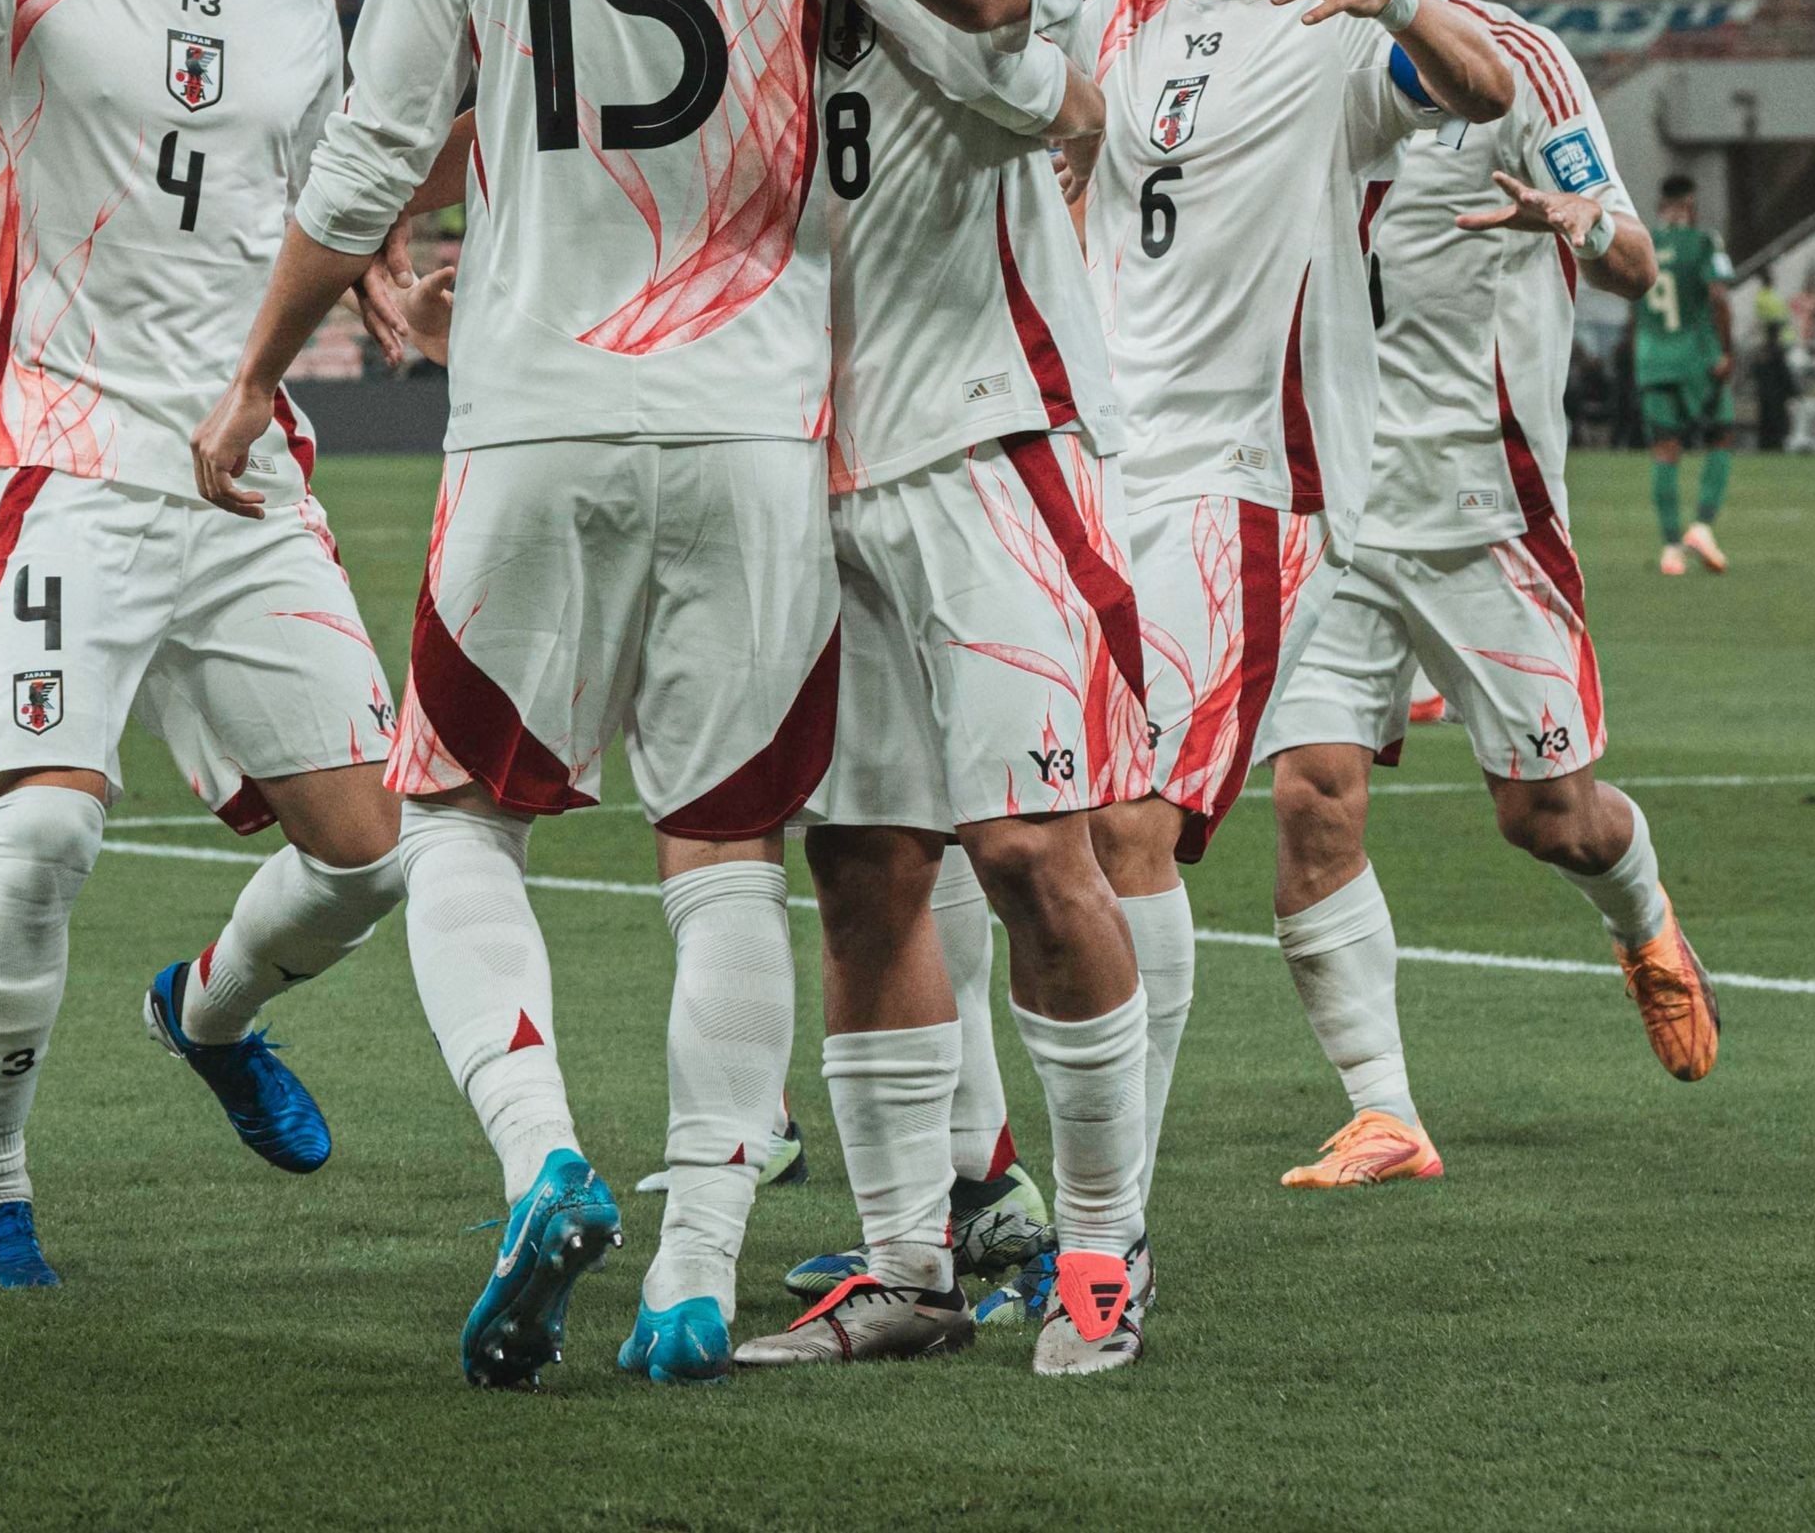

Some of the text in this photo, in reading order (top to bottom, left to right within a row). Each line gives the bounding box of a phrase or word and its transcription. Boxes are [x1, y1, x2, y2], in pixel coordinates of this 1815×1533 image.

[180, 33, 212, 46] JAPAN
[1184, 31, 1223, 60] Y-3
[825, 90, 871, 201] 8
[156, 129, 206, 233] 4
[1139, 165, 1184, 259] 6
[1647, 271, 1681, 332] 9
[13, 563, 62, 651] 4
[23, 671, 52, 680] JAPAN
[1525, 726, 1570, 758] Y-3
[1027, 749, 1075, 783] Y-3
